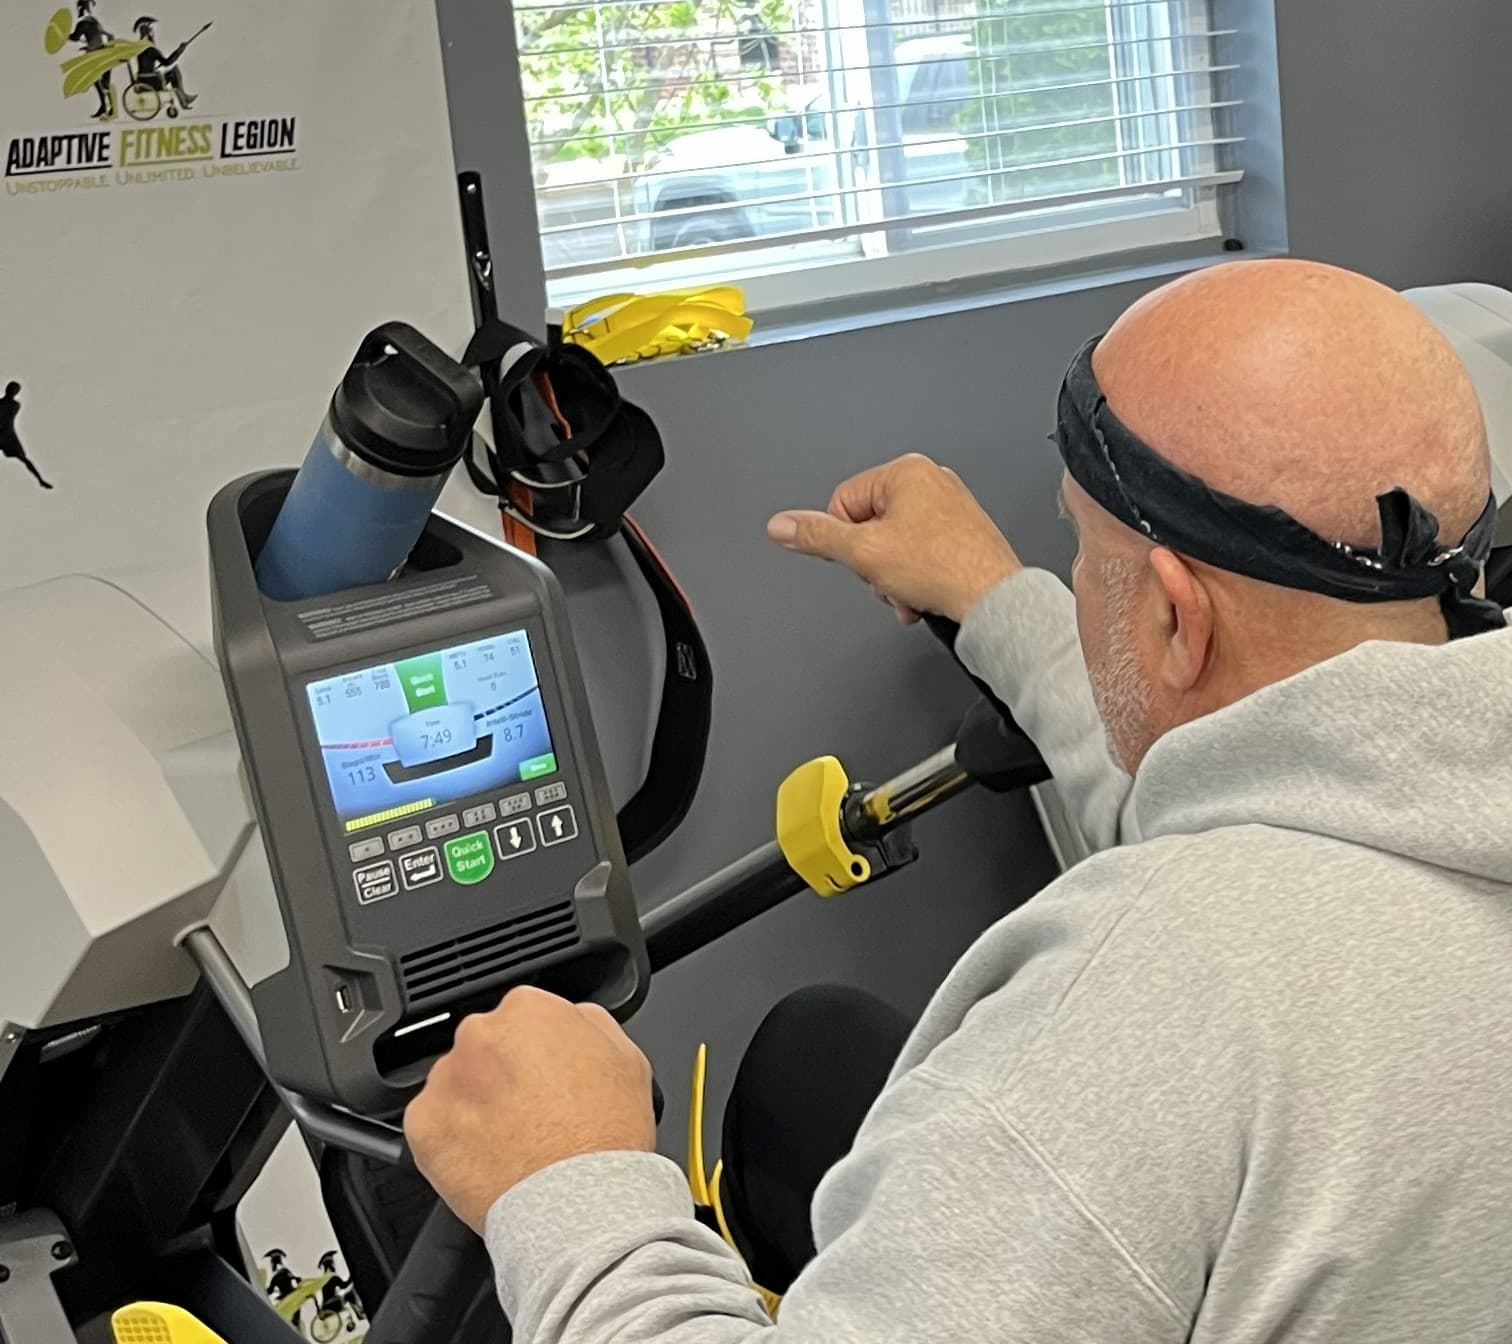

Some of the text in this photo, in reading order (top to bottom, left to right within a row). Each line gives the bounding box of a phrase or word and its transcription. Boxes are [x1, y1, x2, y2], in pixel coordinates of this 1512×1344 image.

[4, 116, 297, 177] ADAPTIVE FITNESS LEGION
[420, 728, 453, 749] 7:49
[503, 723, 525, 742] 8.7
[347, 766, 377, 786] 113
[451, 839, 484, 858] Quick
[403, 853, 435, 872] Enter
[455, 854, 487, 873] Start
[357, 866, 392, 885] Pause
[363, 883, 393, 899] Clear
